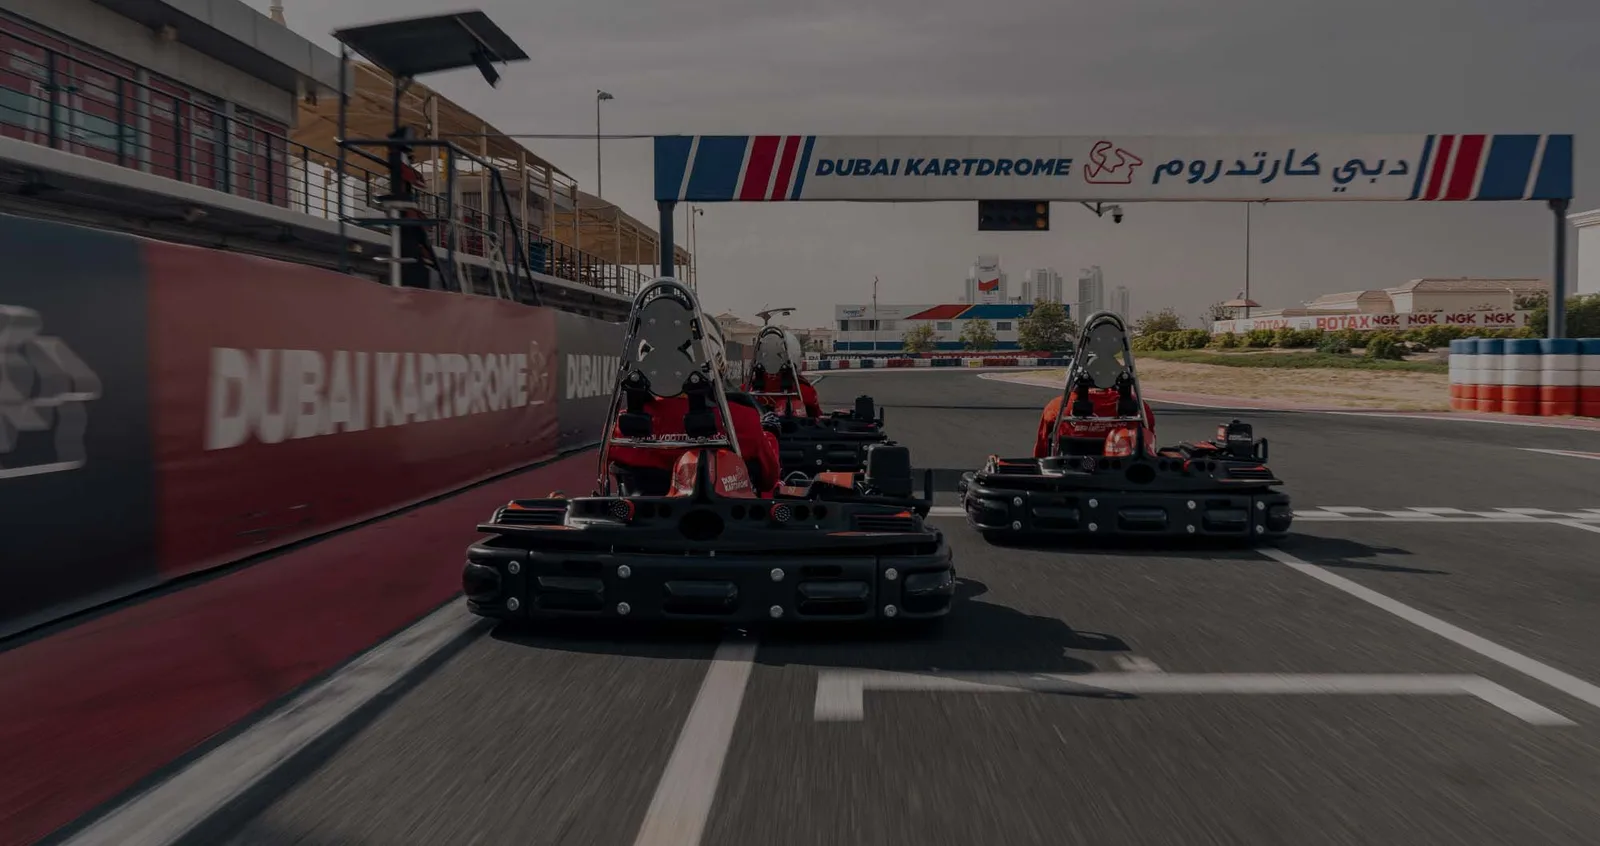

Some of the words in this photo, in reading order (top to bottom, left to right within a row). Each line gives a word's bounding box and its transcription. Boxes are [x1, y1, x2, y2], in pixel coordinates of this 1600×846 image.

[815, 158, 899, 176] DUBAI
[904, 158, 1072, 176] KARTDROME
[1152, 148, 1320, 184] كارتدروم
[1333, 158, 1408, 193] دبي
[1317, 317, 1370, 330] ROTAX
[1372, 315, 1399, 326] NGK
[1408, 314, 1438, 325] NGK
[1446, 313, 1476, 324] NGK
[1485, 313, 1515, 324] NGK
[566, 353, 602, 400] DUBAI
[204, 347, 369, 450] DUBAI
[376, 352, 528, 428] KARTDROME
